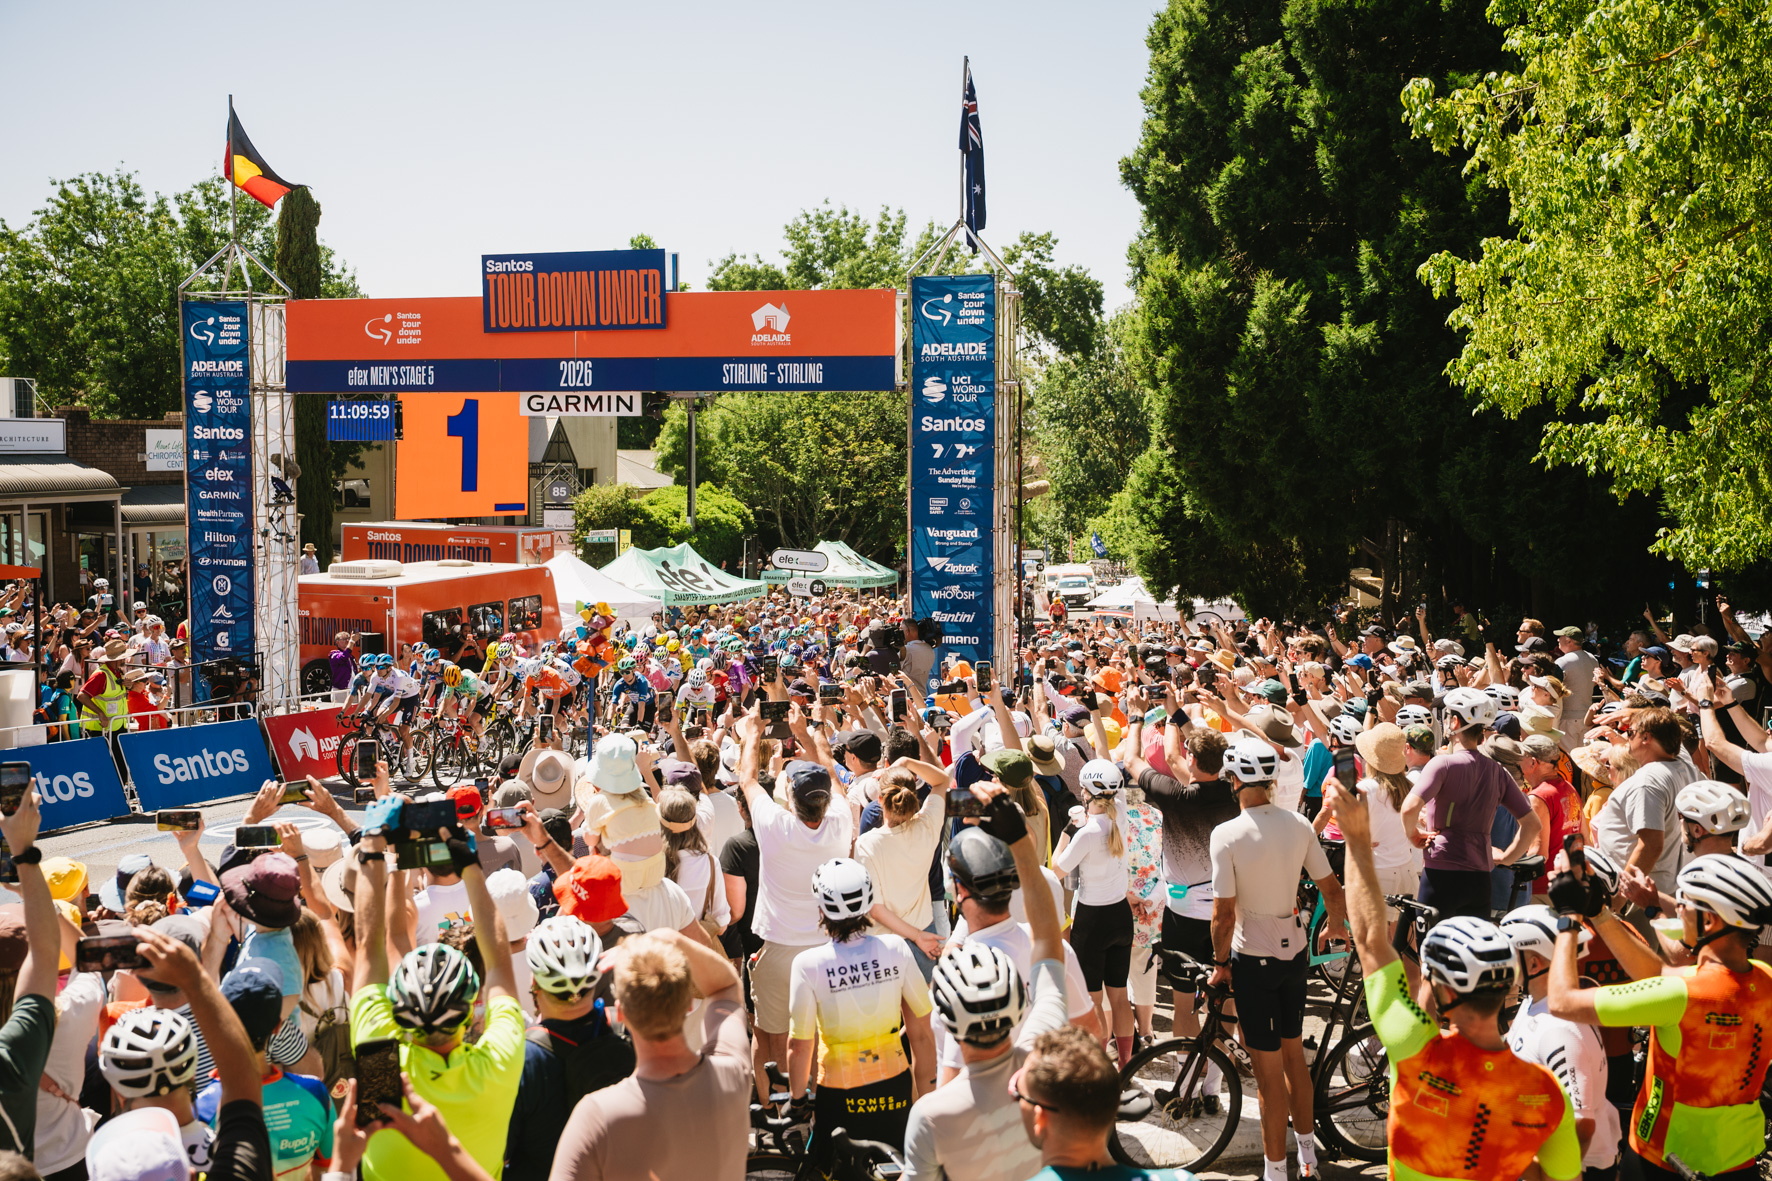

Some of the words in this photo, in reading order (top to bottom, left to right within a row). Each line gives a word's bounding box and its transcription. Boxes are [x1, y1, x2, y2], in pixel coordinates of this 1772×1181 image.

[486, 260, 534, 272] Santos
[486, 273, 536, 328] TOUR
[538, 270, 596, 326] DOWN
[598, 268, 662, 326] UNDER
[921, 343, 987, 355] ADELAIDE
[191, 361, 243, 372] ADELAIDE
[348, 367, 368, 386] efex
[370, 366, 398, 386] MEN'S
[400, 366, 427, 385] STAGE
[428, 366, 434, 385] 5
[559, 360, 593, 388] 2026
[723, 363, 767, 384] STIRLING
[778, 363, 823, 384] STIRLING
[952, 376, 971, 384] UCI
[952, 385, 985, 393] WORLD
[526, 394, 634, 412] GARMIN
[952, 394, 977, 402] TOUR
[330, 404, 390, 420] 11:09:59
[922, 416, 985, 431] Santos
[193, 426, 244, 440] Santos
[154, 440, 170, 450] Mount
[446, 398, 478, 492] 1
[206, 467, 234, 481] efex
[199, 491, 240, 500] GARMIN
[553, 487, 566, 496] 85
[205, 531, 236, 542] Hilton
[367, 531, 401, 542] Santos
[926, 527, 978, 540] Vanguard
[743, 585, 763, 596] BUSINESS
[931, 590, 974, 600] WHOOSH
[932, 611, 976, 622] Santini
[942, 636, 979, 644] IMANO
[154, 747, 250, 785] Santos
[35, 771, 94, 804] tos
[826, 959, 880, 977] HONES
[828, 966, 900, 989] LAWYERS
[1224, 1039, 1252, 1065] cer
[846, 1096, 894, 1106] HONES
[847, 1100, 907, 1113] LAWYERS
[280, 1137, 308, 1150] Bupa
